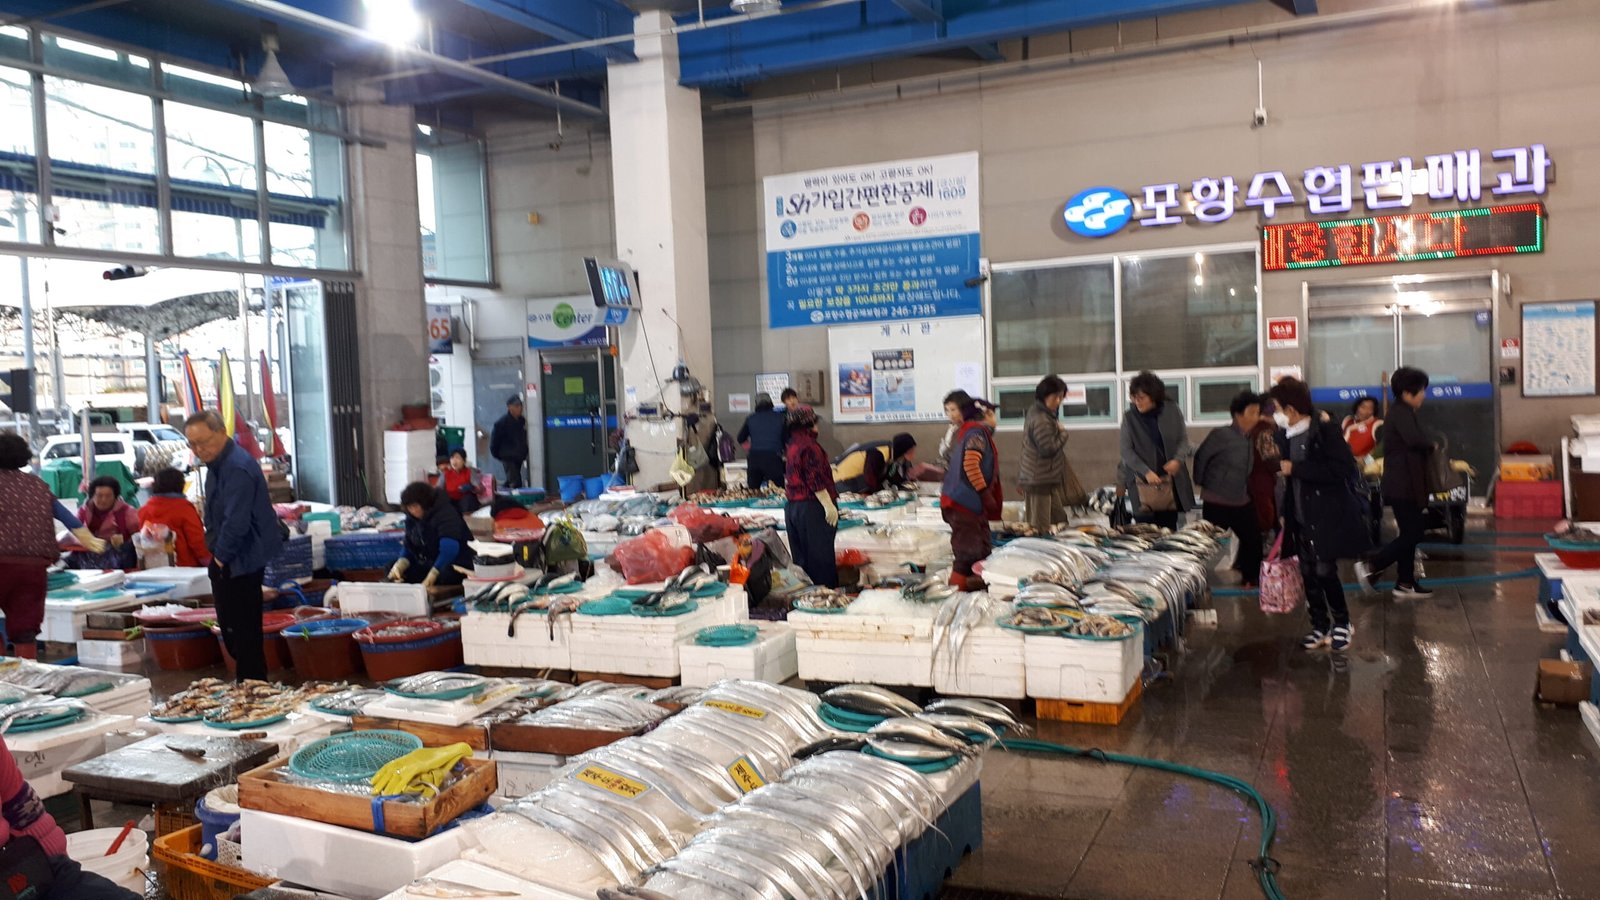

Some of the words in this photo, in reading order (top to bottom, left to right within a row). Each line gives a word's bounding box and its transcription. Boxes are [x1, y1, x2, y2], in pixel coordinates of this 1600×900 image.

[1139, 143, 1551, 227] 포항수협판매과
[890, 302, 937, 317] 246-7385
[427, 318, 450, 340] 65
